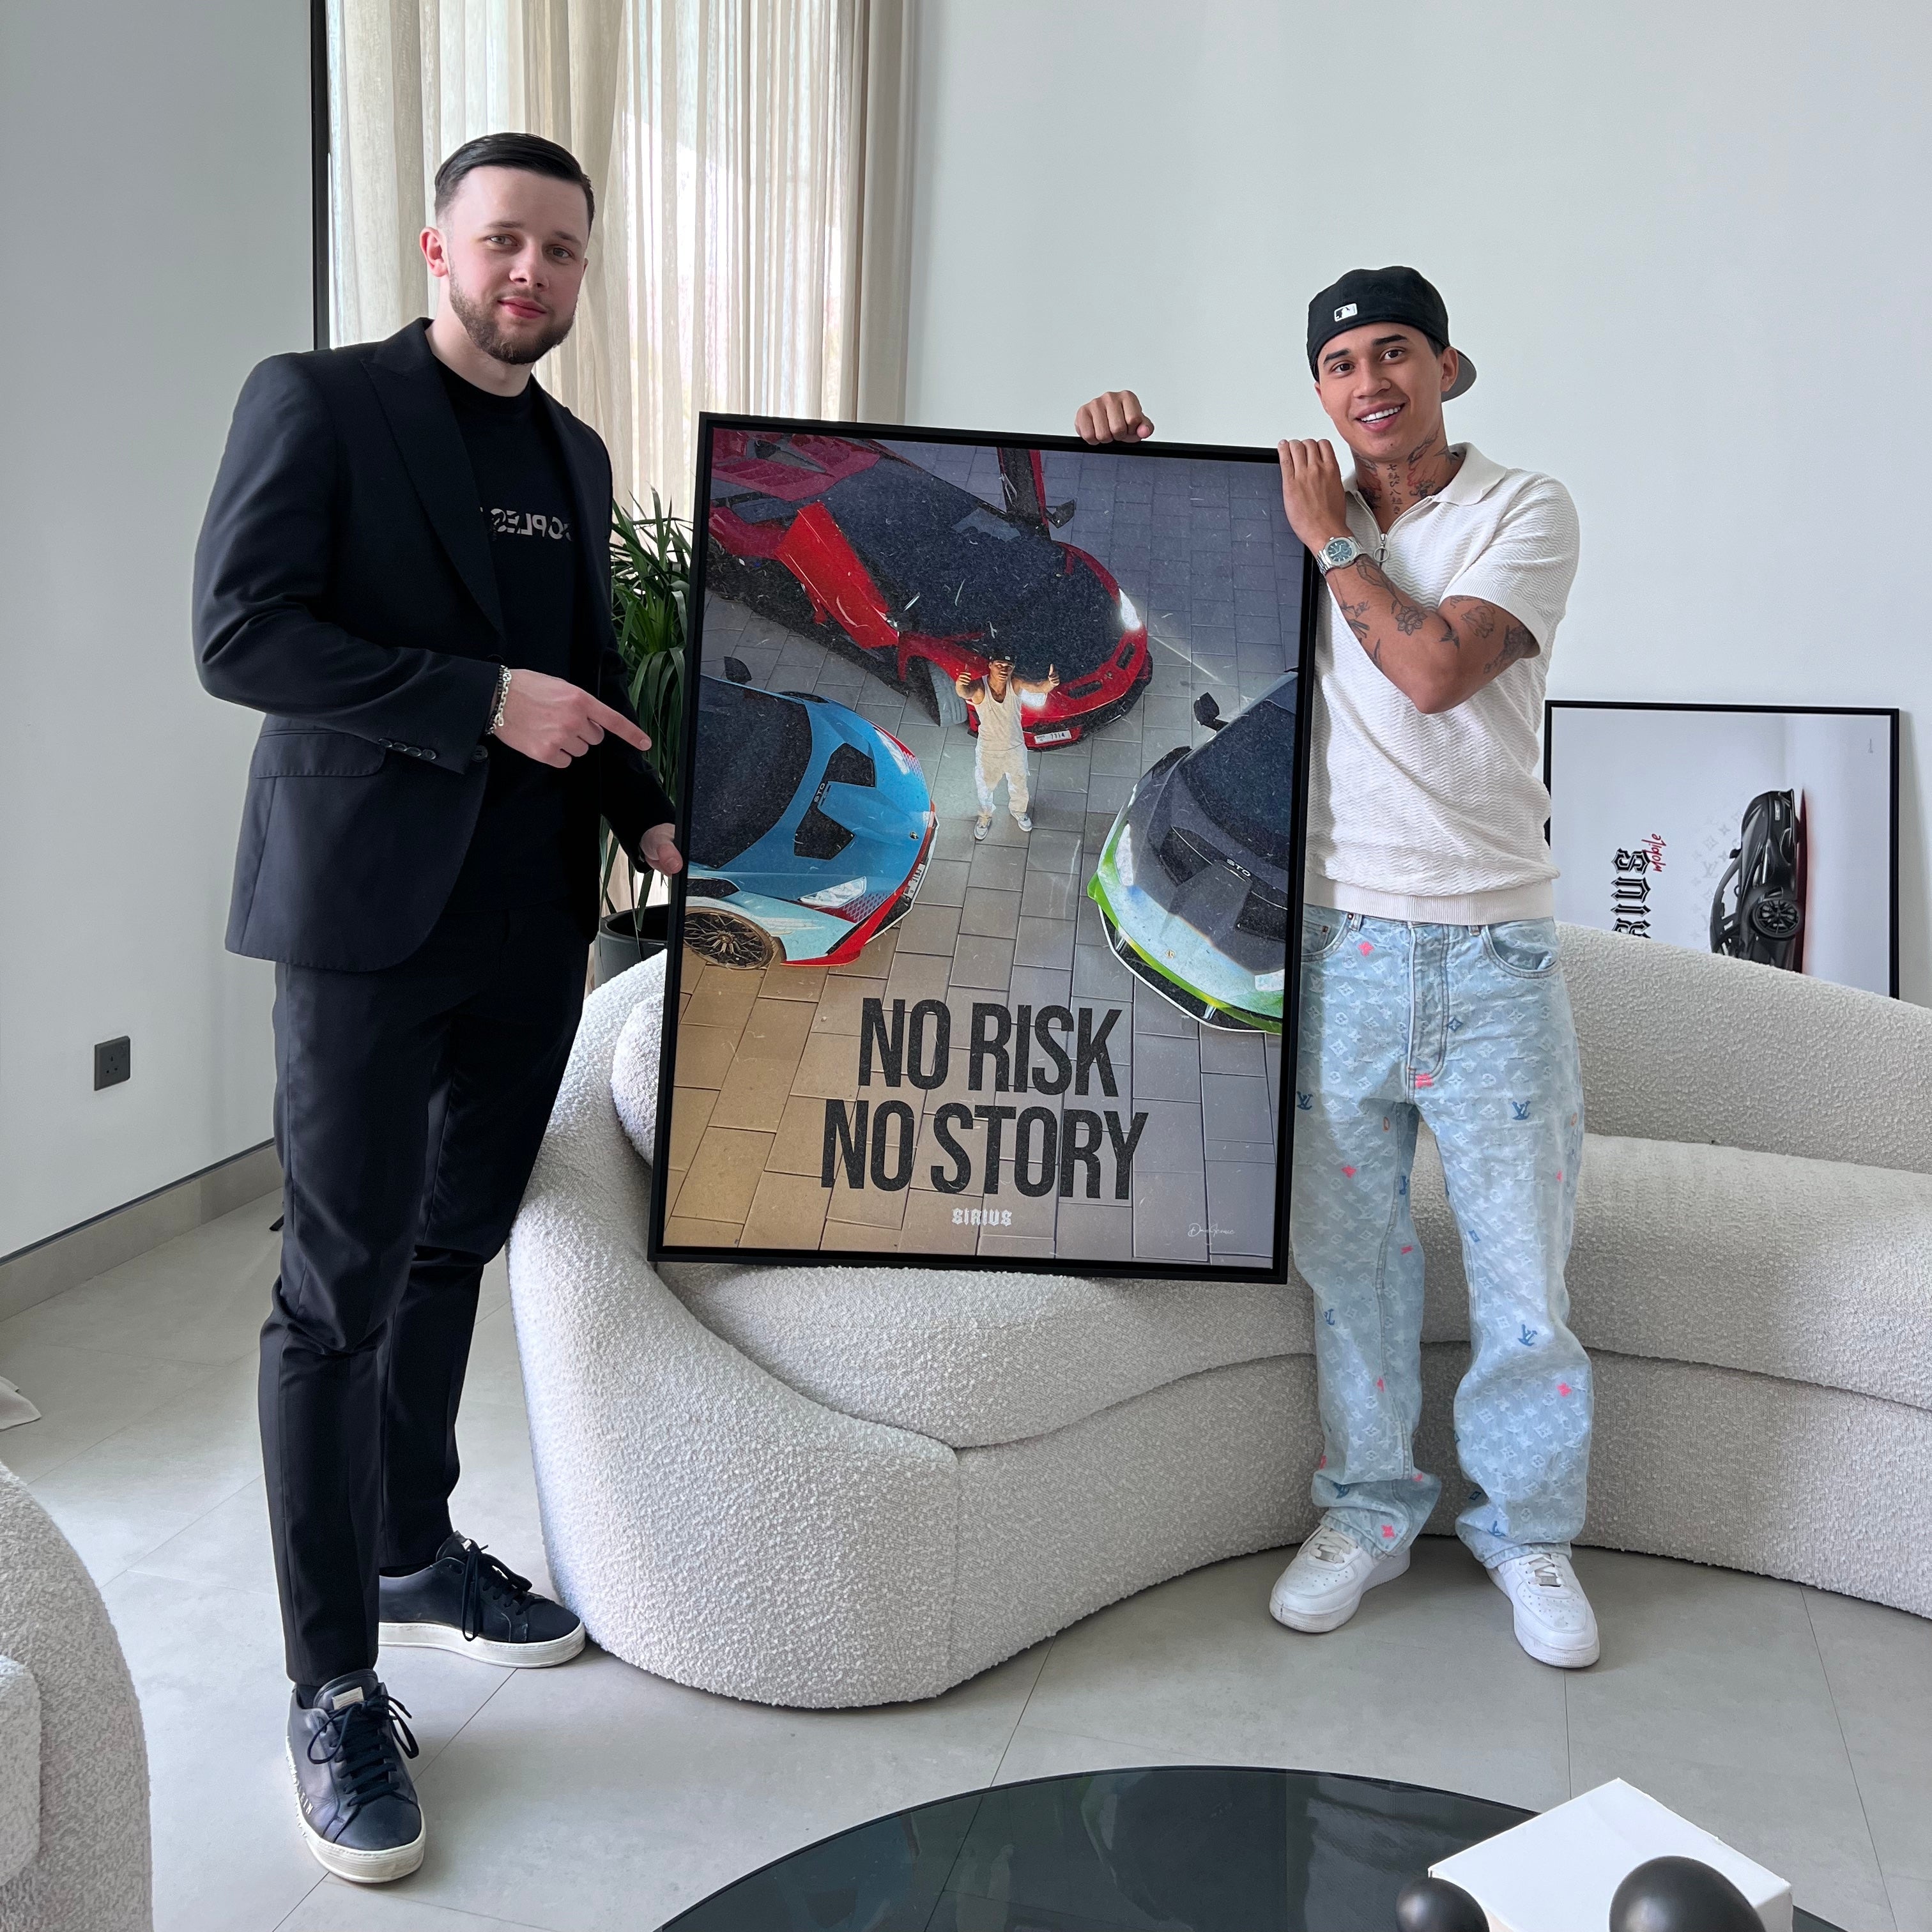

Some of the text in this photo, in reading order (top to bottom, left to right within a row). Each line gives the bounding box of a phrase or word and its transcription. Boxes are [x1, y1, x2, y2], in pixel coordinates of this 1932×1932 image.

[814, 783, 825, 802] STO
[1227, 858, 1251, 877] STO
[1610, 847, 1652, 939] RIUS
[858, 997, 1123, 1098] NO RISK
[821, 1099, 1149, 1200] NO STORY
[951, 1207, 1013, 1227] SIRIUS
